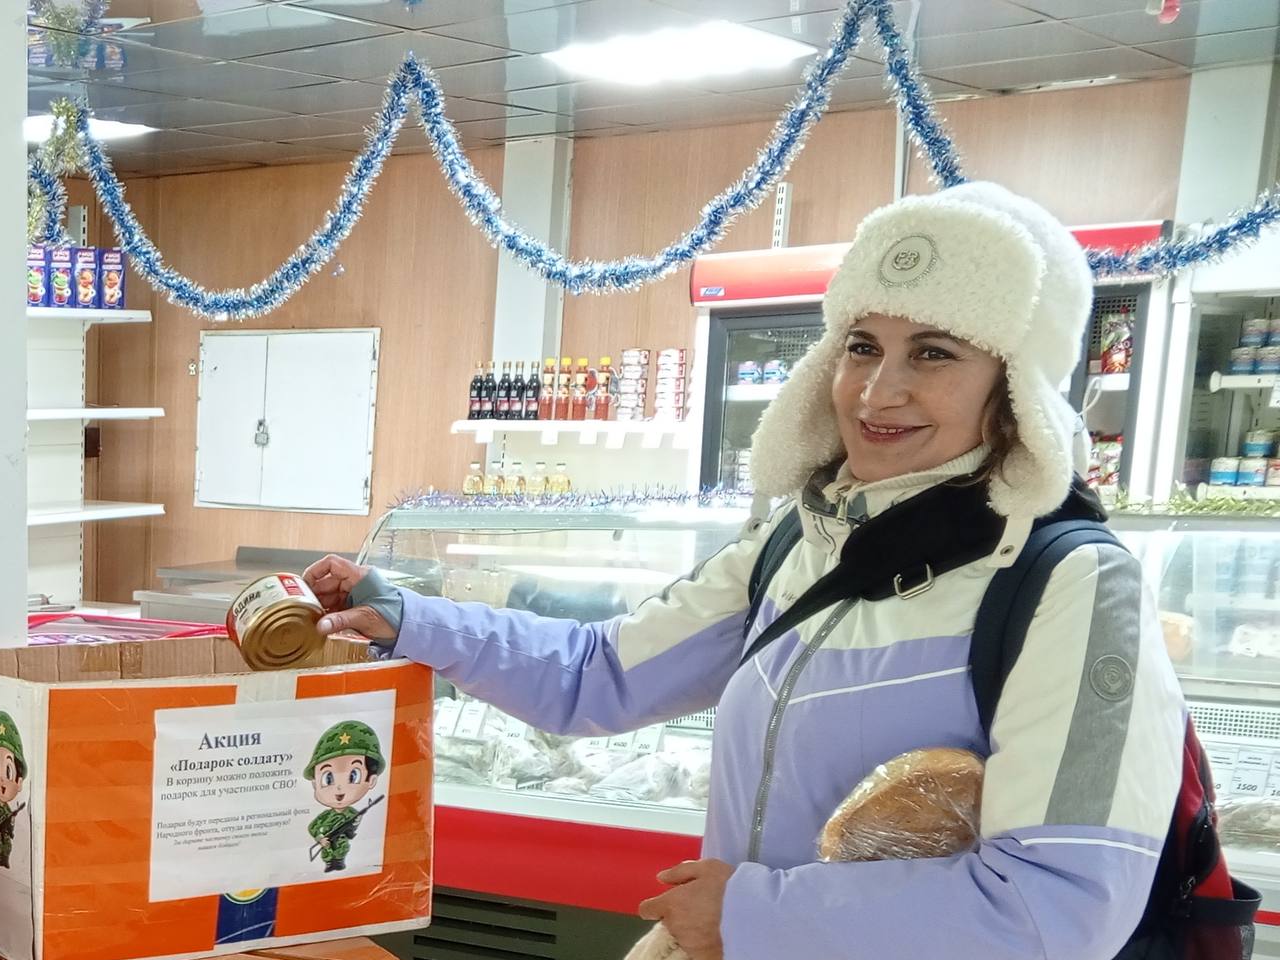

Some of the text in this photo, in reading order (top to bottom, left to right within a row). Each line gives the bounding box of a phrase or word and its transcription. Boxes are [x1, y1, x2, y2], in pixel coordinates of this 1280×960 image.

[198, 732, 261, 750] Акция
[170, 752, 293, 772] «Подарок солдату»
[166, 768, 293, 787] В корзину можно положить
[160, 779, 298, 801] подарок для участников СВО!
